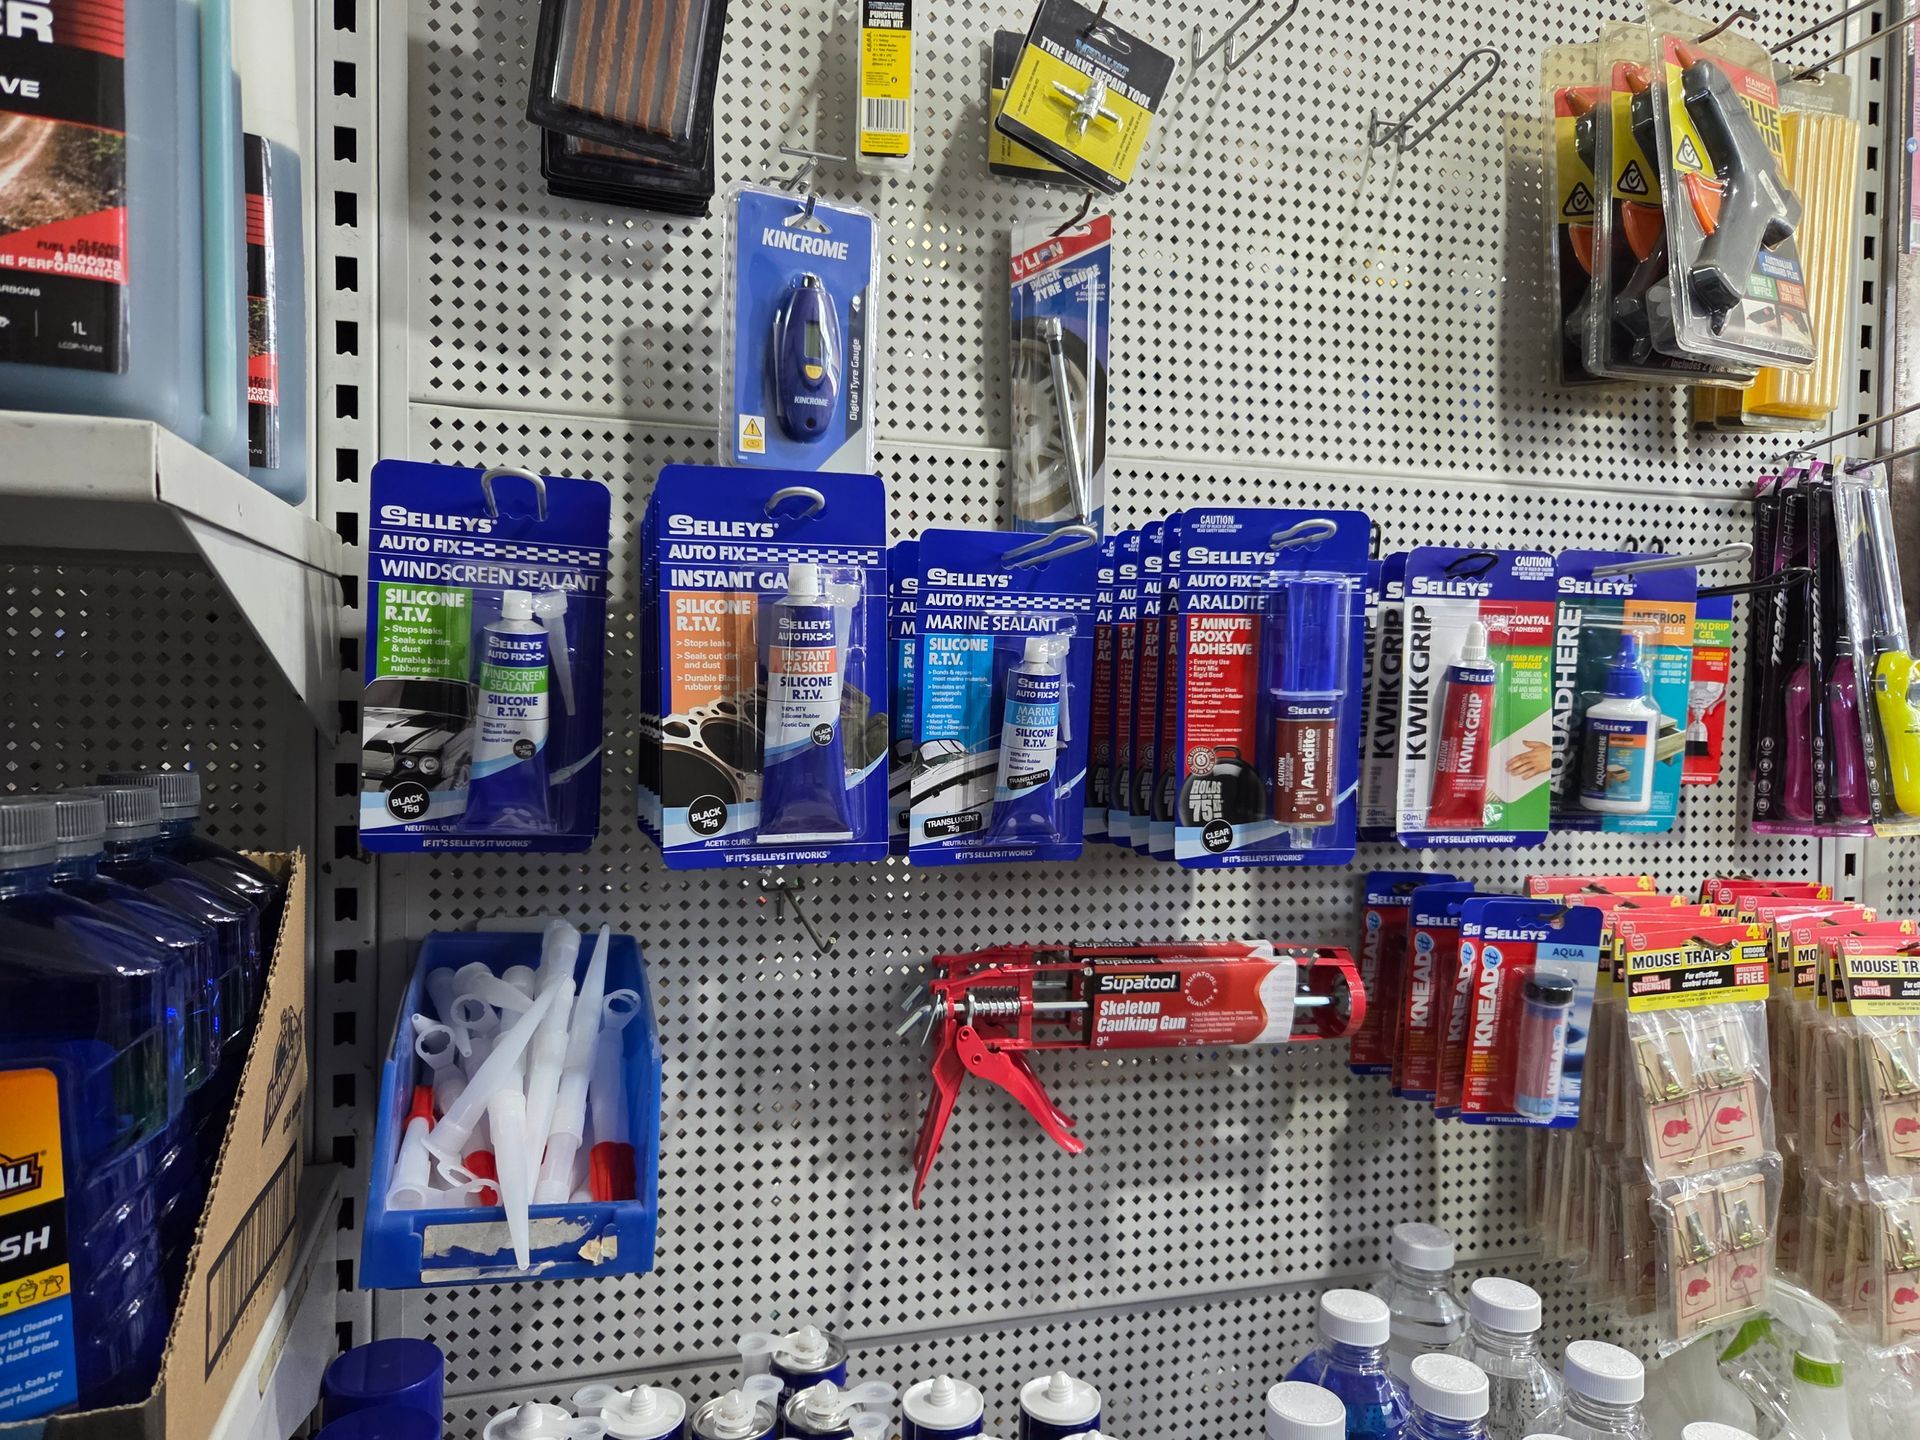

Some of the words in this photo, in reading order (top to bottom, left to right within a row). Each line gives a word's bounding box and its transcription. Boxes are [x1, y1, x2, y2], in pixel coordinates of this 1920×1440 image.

[870, 10, 904, 20] PUNCTURE
[869, 19, 892, 27] REPAIR
[892, 20, 904, 28] KIT
[1040, 36, 1065, 60] TYRE
[1064, 49, 1094, 76] VALVE
[1092, 68, 1128, 95] REPAIR
[1126, 86, 1151, 109] TOOL
[762, 228, 849, 260] KINCROME
[18, 256, 121, 280] PERFORMANCE
[68, 252, 121, 270] BOOSTS
[1033, 282, 1062, 302] TYRE
[1063, 264, 1101, 289] GAUGE
[72, 321, 87, 336] 1L
[851, 339, 861, 368] Gauge
[850, 370, 860, 390] Tyre
[794, 395, 828, 406] KINCROME
[850, 392, 859, 421] Digital
[380, 505, 493, 532] SELLEYS
[668, 514, 775, 538] SELLEYS
[1200, 515, 1234, 524] CAUTION
[379, 534, 430, 552] AUTO
[433, 538, 462, 555] FIX
[669, 544, 716, 561] AUTO
[719, 545, 747, 561] FIX
[1187, 547, 1276, 565] SELLEYS
[1515, 556, 1551, 567] CAUTION
[380, 559, 515, 586] WINDSCREEN
[518, 569, 599, 591] SEALANT
[670, 569, 756, 588] INSTANT
[927, 568, 1008, 587] SELLEYS
[1187, 575, 1227, 587] AUTO
[1230, 575, 1252, 587] FIX
[1770, 591, 1788, 667] reach
[1780, 496, 1796, 559] LIGHTER
[1412, 576, 1489, 596] SELLEYS
[1558, 576, 1634, 596] SELLEYS
[386, 588, 465, 607] SILICONE
[925, 594, 962, 608] AUTO
[965, 595, 986, 608] FIX
[1187, 594, 1264, 610] ARALDITE
[676, 598, 751, 614] SILICONE
[385, 606, 432, 622] R.T.V.
[1484, 614, 1551, 626] HORIZONTAL
[1633, 612, 1686, 624] INTERIOR
[676, 616, 721, 631] R.T.V.
[779, 618, 831, 630] SELLEYS
[925, 614, 988, 630] MARINE
[993, 617, 1057, 633] SEALANT
[1190, 618, 1198, 630] 5
[1201, 618, 1252, 630] MINUTE
[1664, 626, 1685, 635] GLUE
[1811, 588, 1822, 666] reach
[778, 632, 800, 640] AUTO
[802, 632, 816, 640] FIX
[1190, 630, 1234, 642] EPOXY
[1699, 631, 1715, 639] GEL
[488, 636, 542, 650] SELLEYS
[930, 638, 988, 651] SILICONE
[1189, 643, 1252, 655] ADHESIVE
[929, 652, 963, 666] R.T.V.
[482, 667, 545, 681] WINDSCREEN
[784, 662, 829, 673] GASKET
[490, 681, 536, 692] SEALANT
[488, 695, 538, 706] SILICONE
[497, 707, 527, 717] R.T.V.
[1016, 728, 1054, 737] SILICONE
[1594, 722, 1632, 732] SELLEYS
[1301, 729, 1316, 788] Araldite
[1438, 740, 1448, 771] CAUTION
[1596, 736, 1606, 786] AQUADHERE
[1190, 780, 1221, 794] HOLDS
[391, 793, 424, 808] BLACK
[402, 804, 420, 813] 75g
[691, 807, 722, 822] BLACK
[701, 819, 718, 828] 75g
[926, 814, 980, 828] TRANSLUCENT
[1205, 828, 1230, 840] CLEAR
[1209, 837, 1229, 847] 24mL
[1484, 927, 1547, 940] SELLEYS
[1552, 947, 1584, 958] AQUA
[1632, 952, 1680, 969] MOUSE
[1685, 950, 1730, 963] TRAPS
[1100, 974, 1176, 994] Supatool
[1185, 971, 1217, 987] SUPATOOL
[1682, 980, 1701, 988] control
[1736, 972, 1764, 985] FREE
[1410, 952, 1431, 1027] KNEAD
[1632, 979, 1671, 994] STRENGTH
[1854, 985, 1891, 997] STRENGTH
[1100, 1000, 1160, 1016] Skeleton
[1186, 994, 1214, 1007] QUALITY
[1448, 962, 1472, 1041] KNEAD
[1474, 966, 1500, 1048] KNEAD
[1097, 1017, 1158, 1032] Caulking
[1160, 1016, 1186, 1030] Gun
[0, 1226, 50, 1262] SH
[23, 1314, 63, 1333] Cleaners
[8, 1339, 23, 1350] Lift
[26, 1331, 50, 1344] Away
[6, 1349, 29, 1363] Road
[32, 1340, 59, 1354] Grime
[25, 1376, 46, 1389] Safe
[48, 1370, 63, 1380] For
